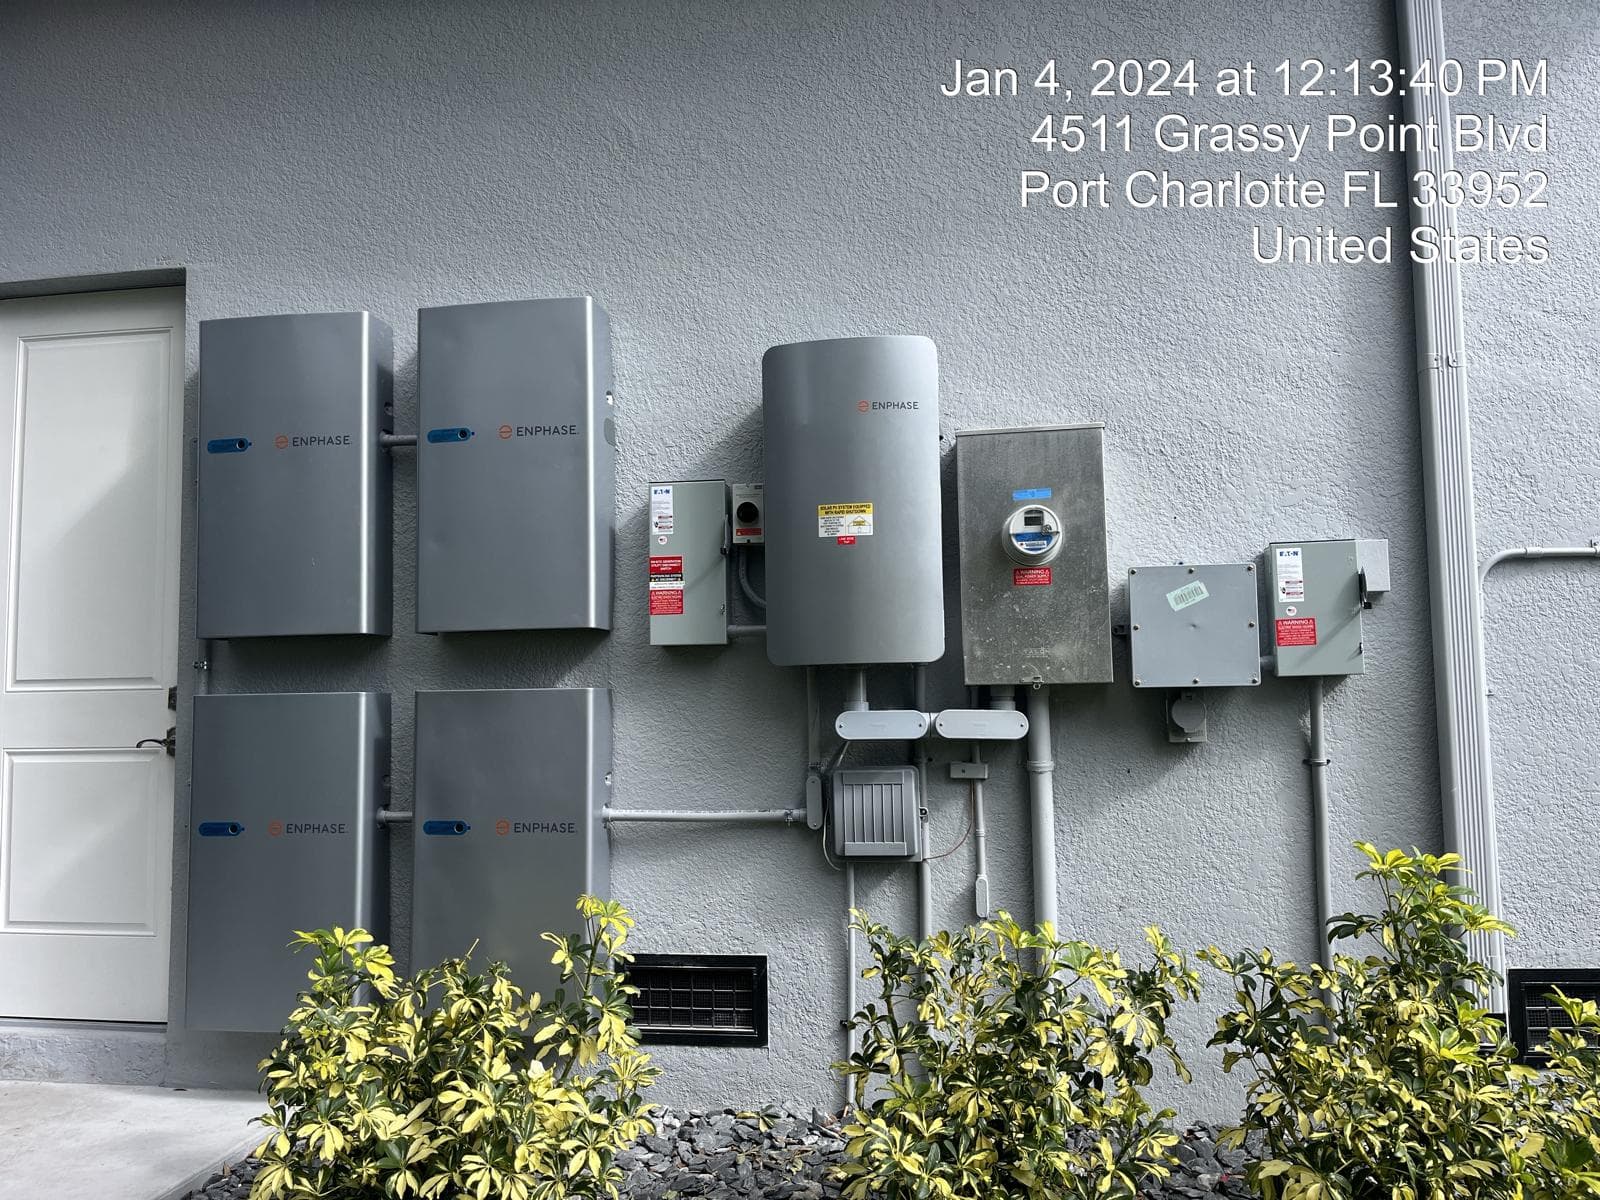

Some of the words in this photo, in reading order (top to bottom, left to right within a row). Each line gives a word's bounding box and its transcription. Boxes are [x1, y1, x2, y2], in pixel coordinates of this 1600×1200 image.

[871, 401, 919, 410] ENPHASE
[516, 425, 577, 437] ENPHASE
[292, 435, 351, 448] ENPHASE
[286, 823, 346, 834] ENPHASE
[514, 822, 576, 834] ENPHASE
